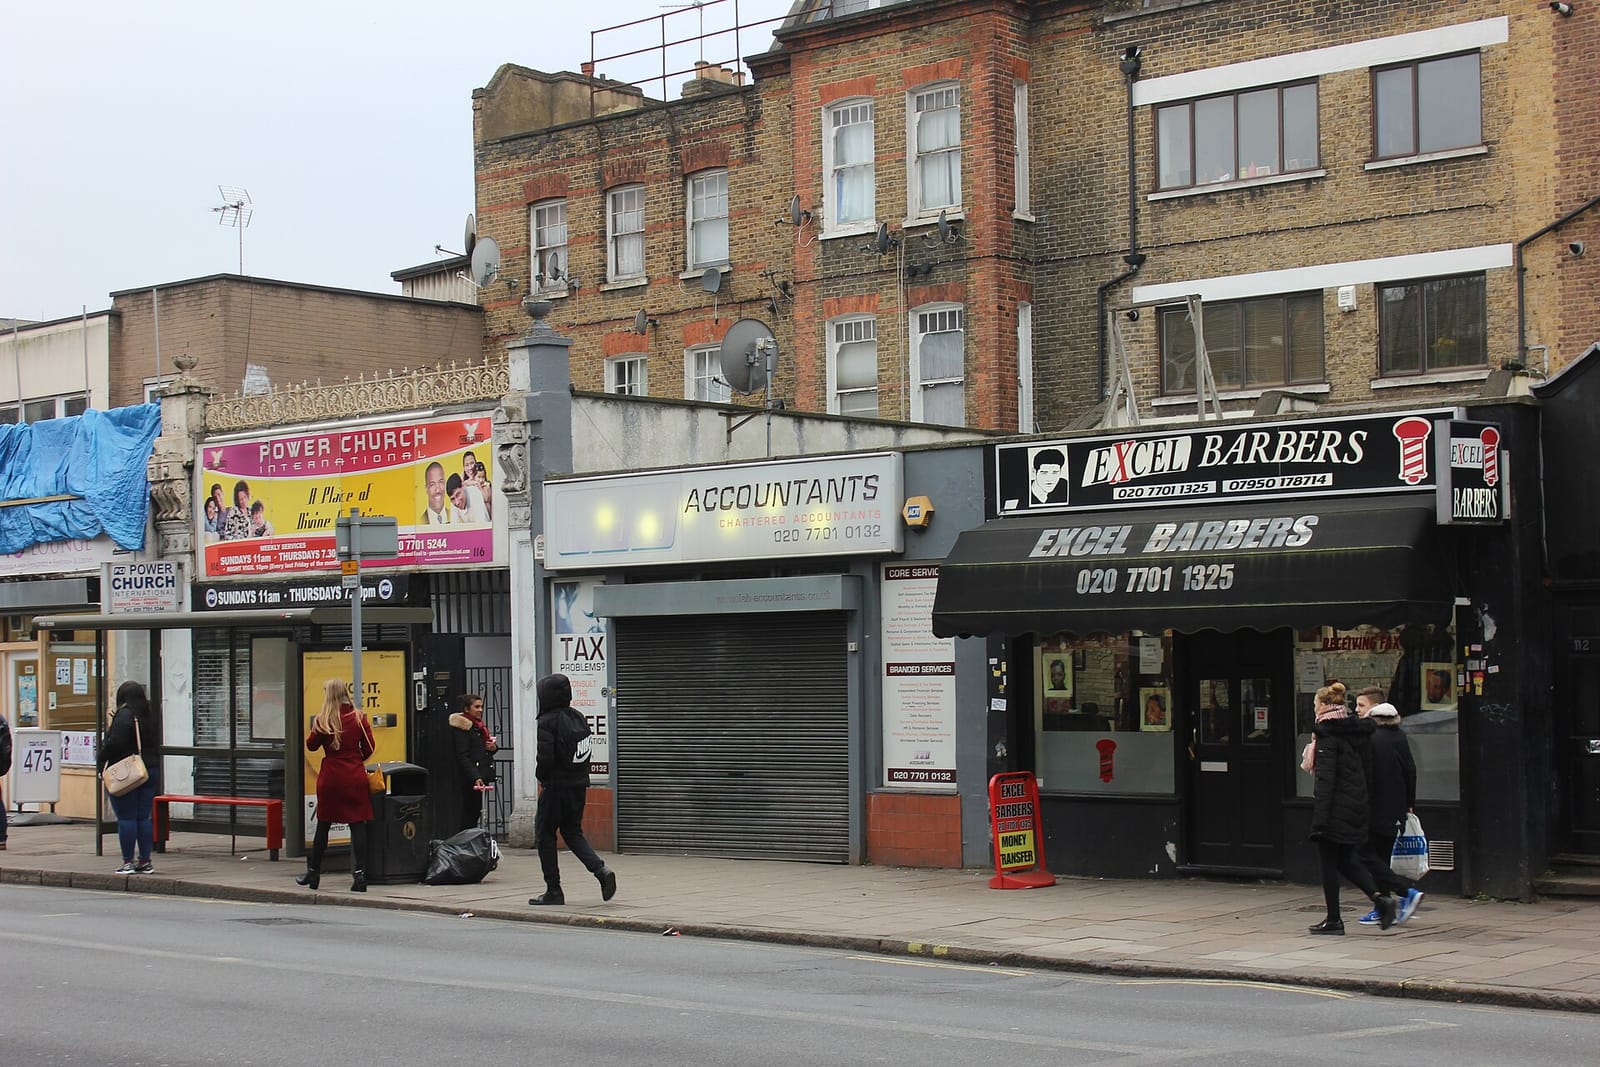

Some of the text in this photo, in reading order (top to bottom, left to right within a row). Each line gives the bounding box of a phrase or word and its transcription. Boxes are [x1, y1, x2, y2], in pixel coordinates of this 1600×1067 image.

[259, 427, 427, 463] POWER CHURCH
[1451, 443, 1482, 464] EXCEL
[259, 450, 427, 474] INTERNATIONAL
[1091, 430, 1368, 483] EXCEL BARBERS
[1118, 483, 1209, 498] 020 7701 1325
[1228, 474, 1327, 491] 07950 178714
[308, 483, 373, 504] A Place of
[685, 475, 880, 513] ACCOUNTANTS
[1453, 487, 1498, 518] BARBERS
[719, 509, 881, 528] CHARTERED ACCOUNTANTS
[775, 525, 881, 542] 020 7701 0132
[1028, 515, 1320, 558] EXCEL BARBERS
[405, 539, 424, 550] 7701
[427, 538, 447, 549] 5244
[220, 548, 337, 566] SUNDAYS 11am THURSDAYS 7.30
[129, 564, 173, 575] POWER
[889, 567, 939, 578] CORE SERVIC
[112, 576, 175, 590] CHURCH
[1076, 563, 1236, 595] 020 7701 1325
[112, 589, 175, 598] INTERNATIONAL
[218, 590, 256, 605] SUNDAYS
[258, 589, 280, 603] 11am
[289, 586, 342, 602] THURSDAYS
[560, 636, 605, 661] TAX
[1322, 637, 1376, 651] RECEIVING
[560, 662, 605, 672] PROBLEMS?
[890, 665, 952, 673] BRANDED SERVICES
[586, 715, 606, 735] EE
[24, 749, 52, 773] 475
[591, 764, 607, 772] 0132
[893, 771, 951, 780] 020 7701 0132
[1001, 783, 1025, 798] EXCEL
[996, 803, 1033, 819] BARBERS
[1001, 834, 1027, 849] MONEY
